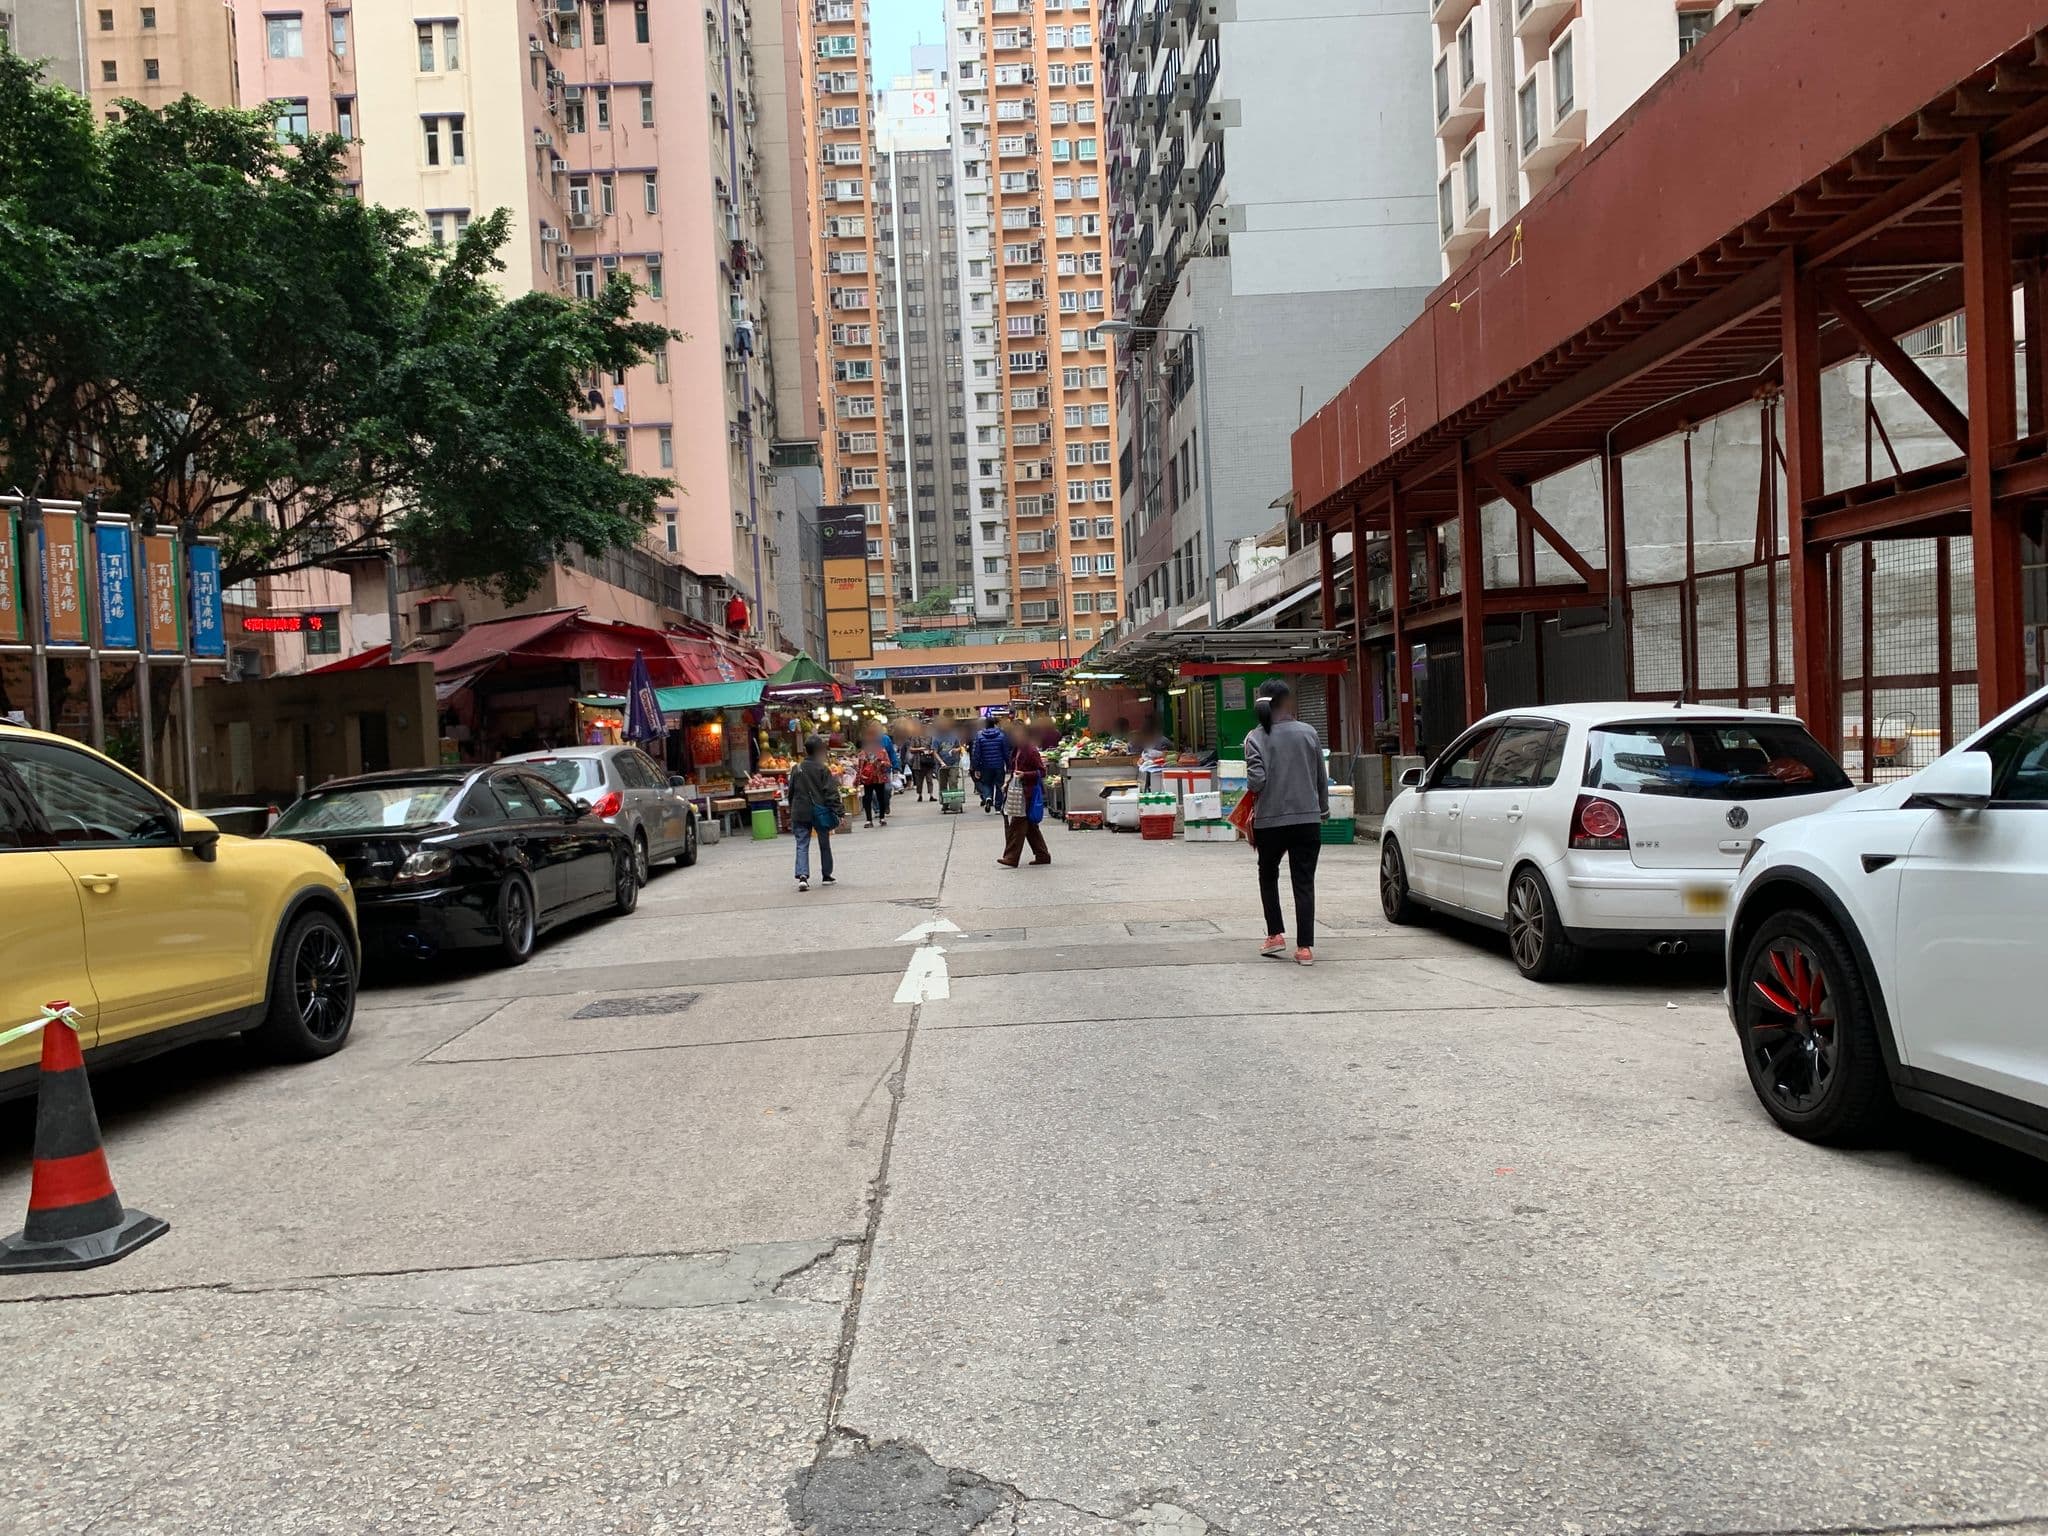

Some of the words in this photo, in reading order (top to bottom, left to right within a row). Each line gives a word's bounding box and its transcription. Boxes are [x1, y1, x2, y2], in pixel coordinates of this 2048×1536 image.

[49, 542, 59, 575] square
[57, 544, 76, 612] 百利達廣場
[100, 552, 109, 584] square
[51, 577, 61, 618] paradise
[102, 585, 112, 624] paradise
[108, 554, 125, 618] 百利達廣場
[155, 563, 172, 624] 百利達廣場
[199, 572, 215, 630] 百利達廣場
